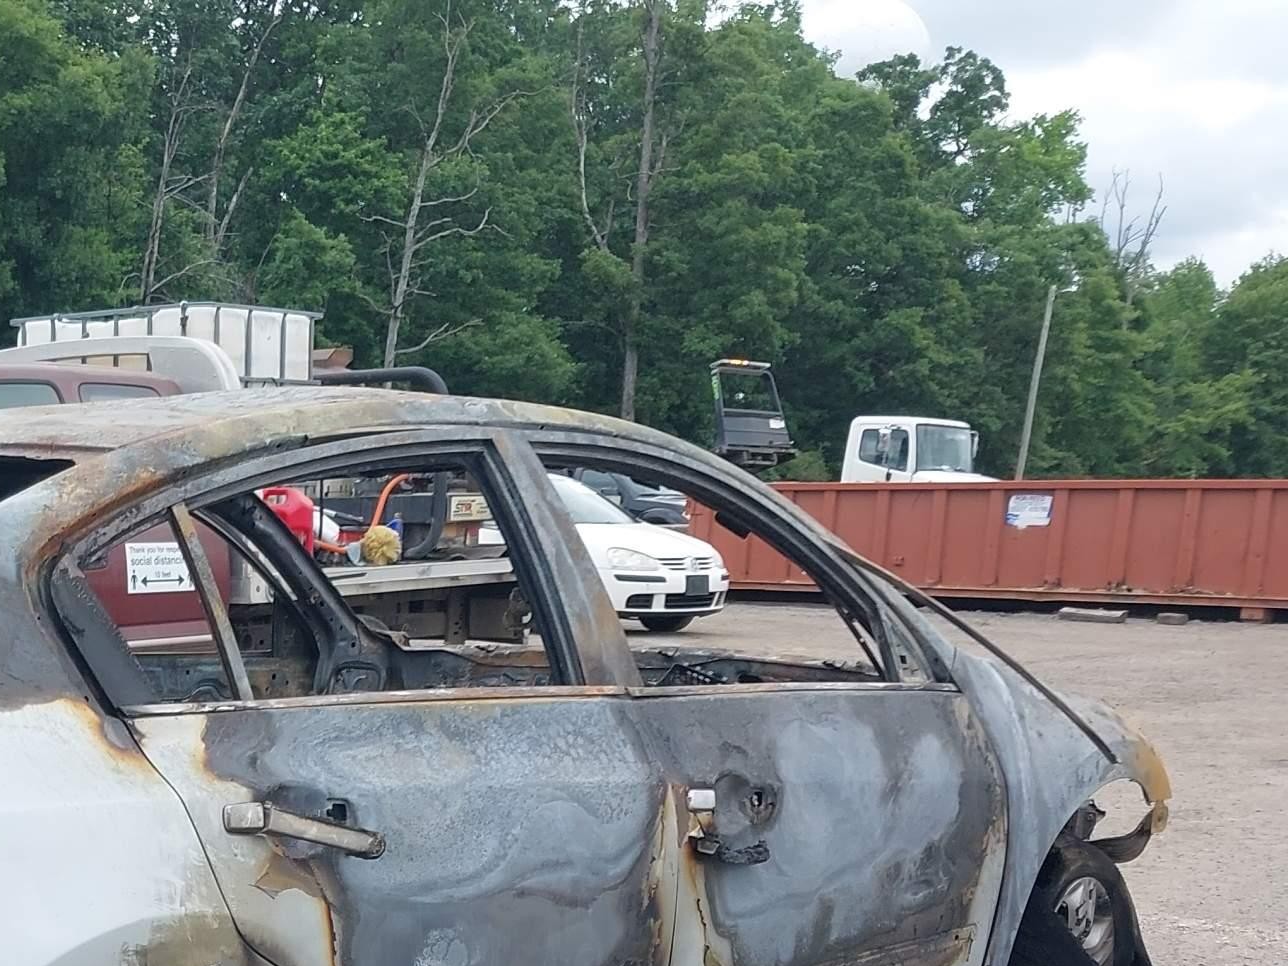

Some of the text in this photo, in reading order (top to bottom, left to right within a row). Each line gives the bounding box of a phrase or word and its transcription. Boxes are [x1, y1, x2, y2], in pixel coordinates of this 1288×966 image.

[129, 546, 145, 554] Thank
[147, 547, 156, 555] you
[130, 555, 152, 566] social
